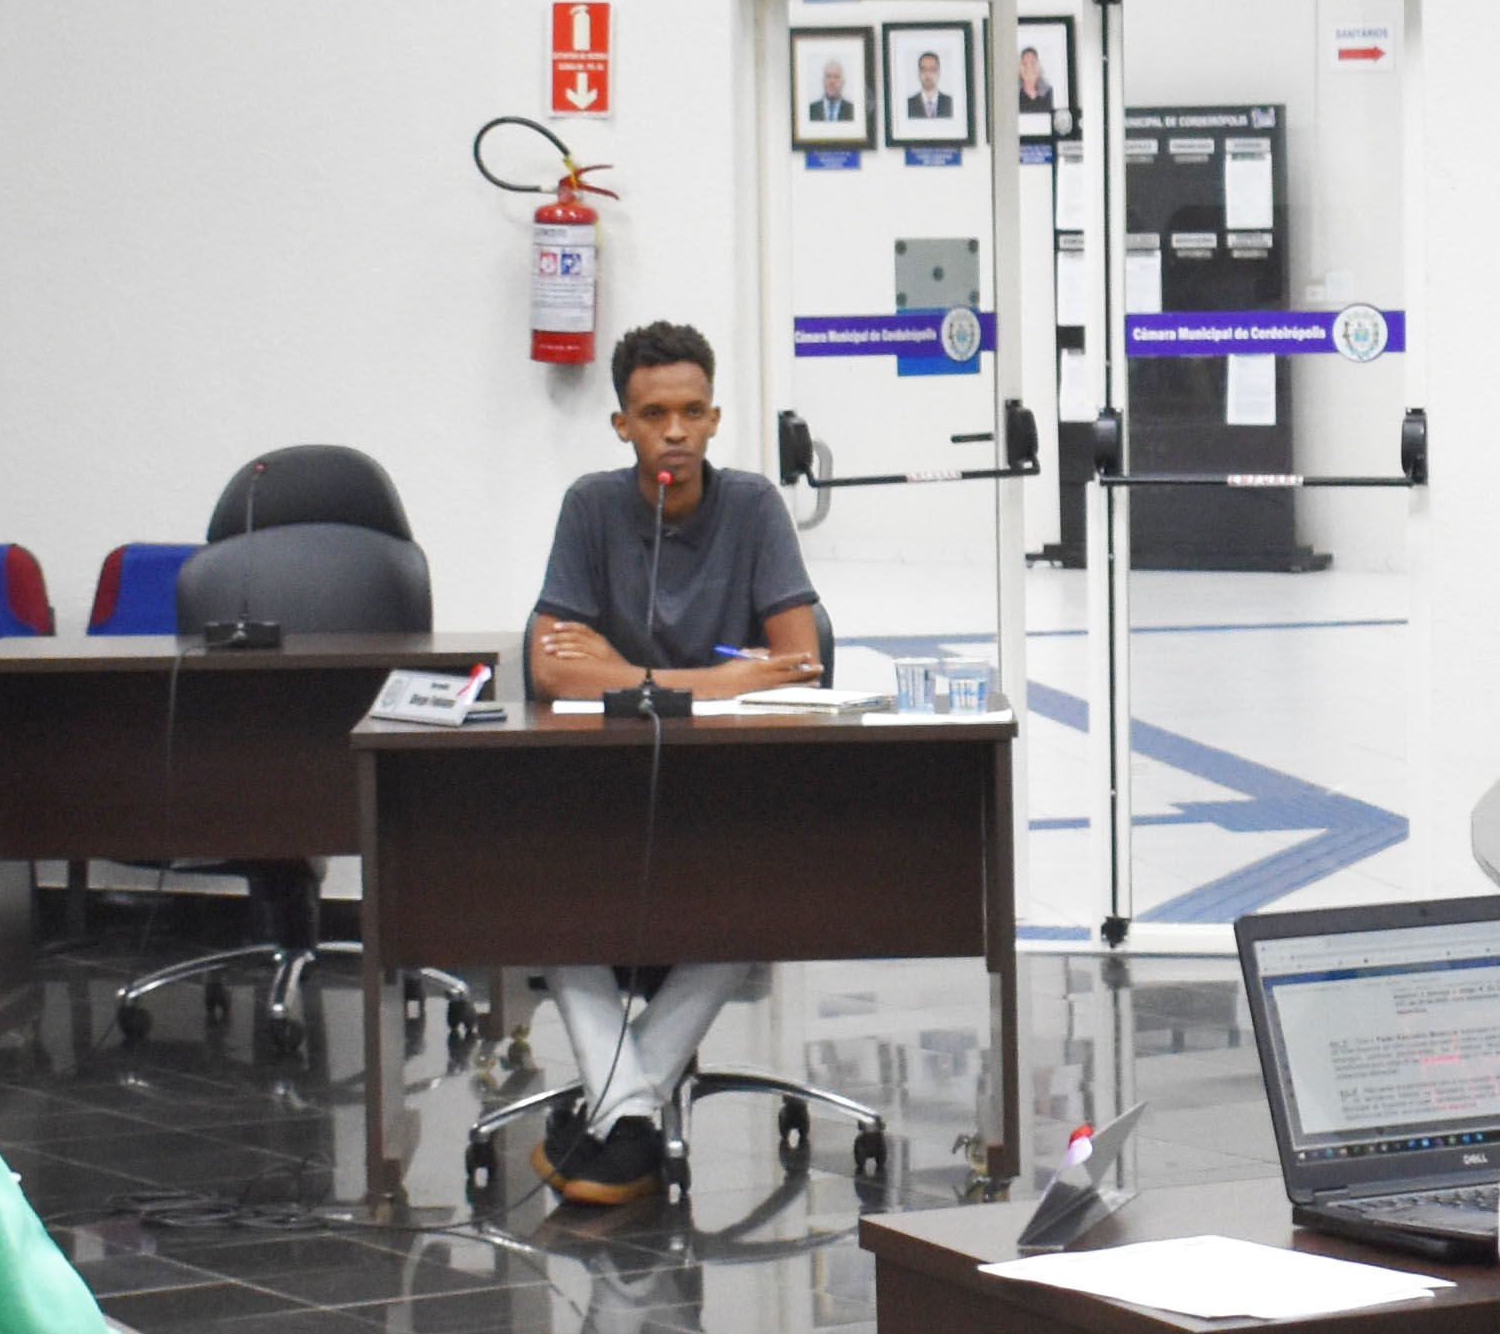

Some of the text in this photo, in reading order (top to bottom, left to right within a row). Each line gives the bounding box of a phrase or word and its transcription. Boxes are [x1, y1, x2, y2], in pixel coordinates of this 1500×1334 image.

[1132, 325, 1326, 342] Câmara Municipal de Cordeirópolis
[1463, 1153, 1489, 1165] DELL
